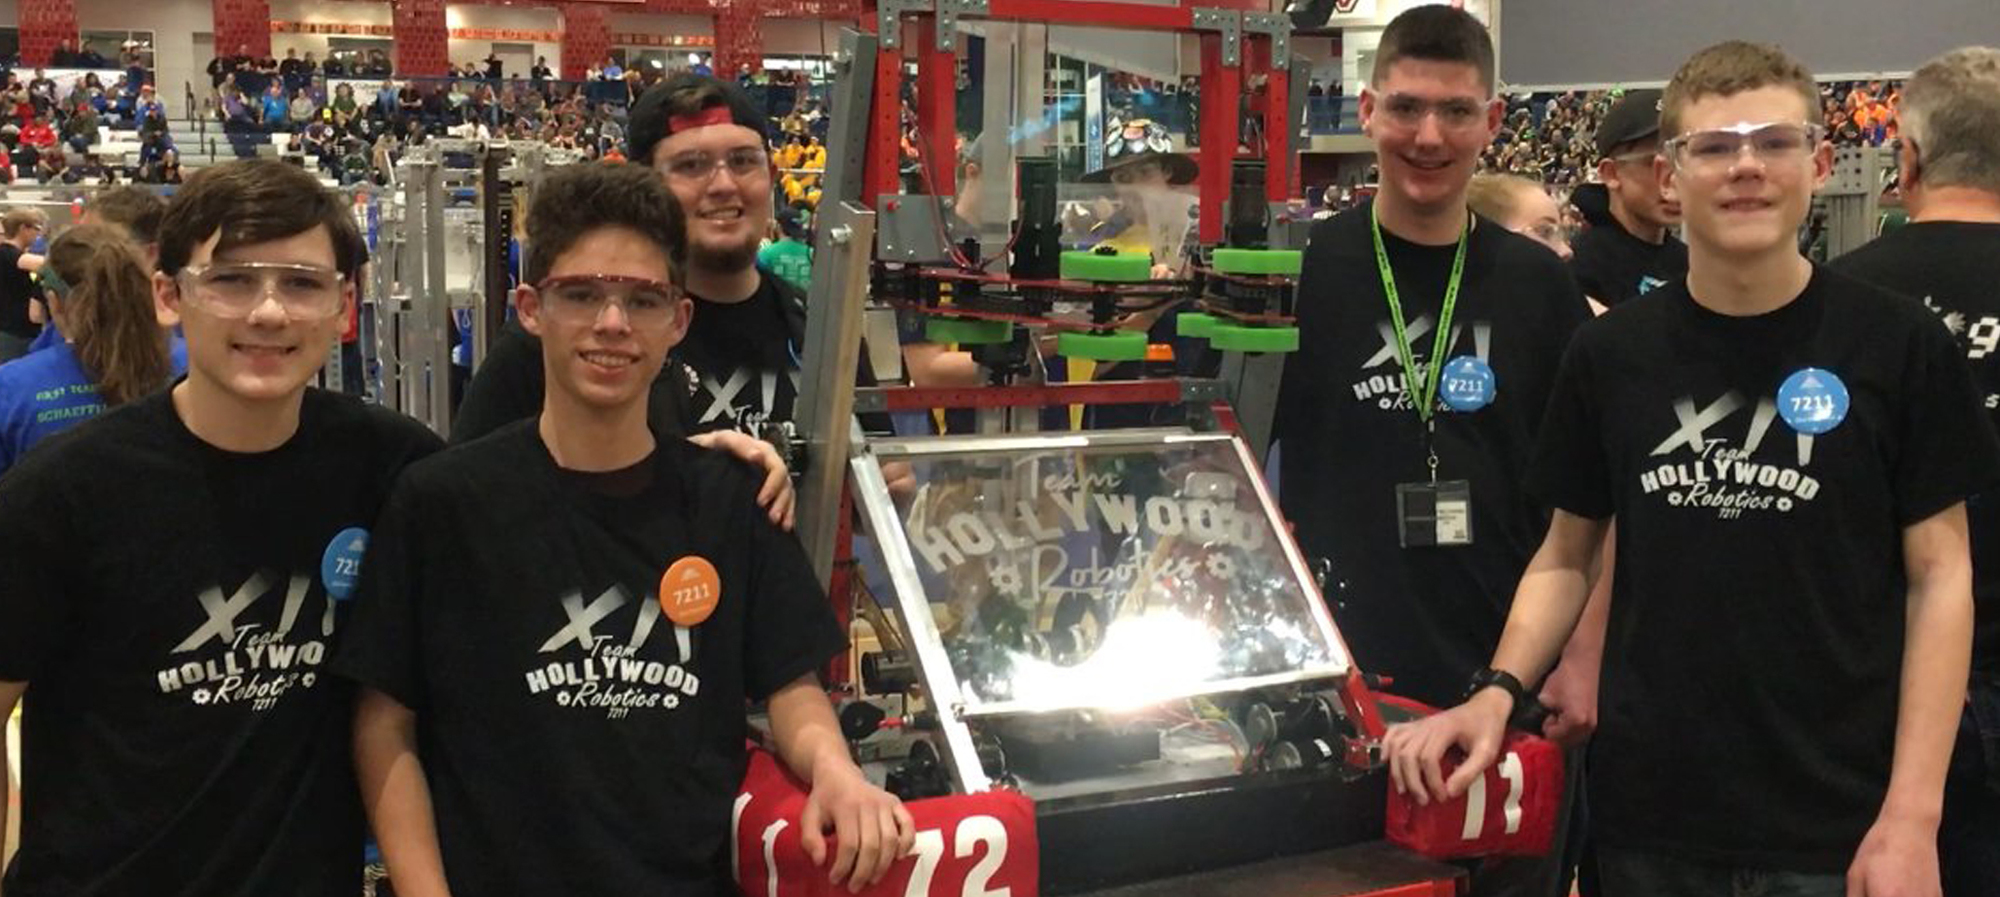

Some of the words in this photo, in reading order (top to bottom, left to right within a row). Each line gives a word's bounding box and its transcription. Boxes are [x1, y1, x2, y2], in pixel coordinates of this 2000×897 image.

[1448, 379, 1485, 393] 7211
[1790, 394, 1836, 412] 7211
[1701, 438, 1751, 461] Team
[1013, 449, 1122, 501] Team
[1640, 458, 1820, 501] HOLLYWOOD
[1683, 482, 1774, 509] Robotics
[1718, 508, 1742, 519] 7211
[907, 490, 1263, 574] HOLLYWOOD
[334, 556, 360, 576] 721
[673, 583, 711, 605] 7211
[232, 623, 286, 650] Team
[591, 635, 639, 658] Team
[526, 656, 700, 696] HOLLYWOOD
[252, 697, 278, 711] 7211
[571, 682, 661, 708] Robotics
[606, 707, 629, 719] 7211
